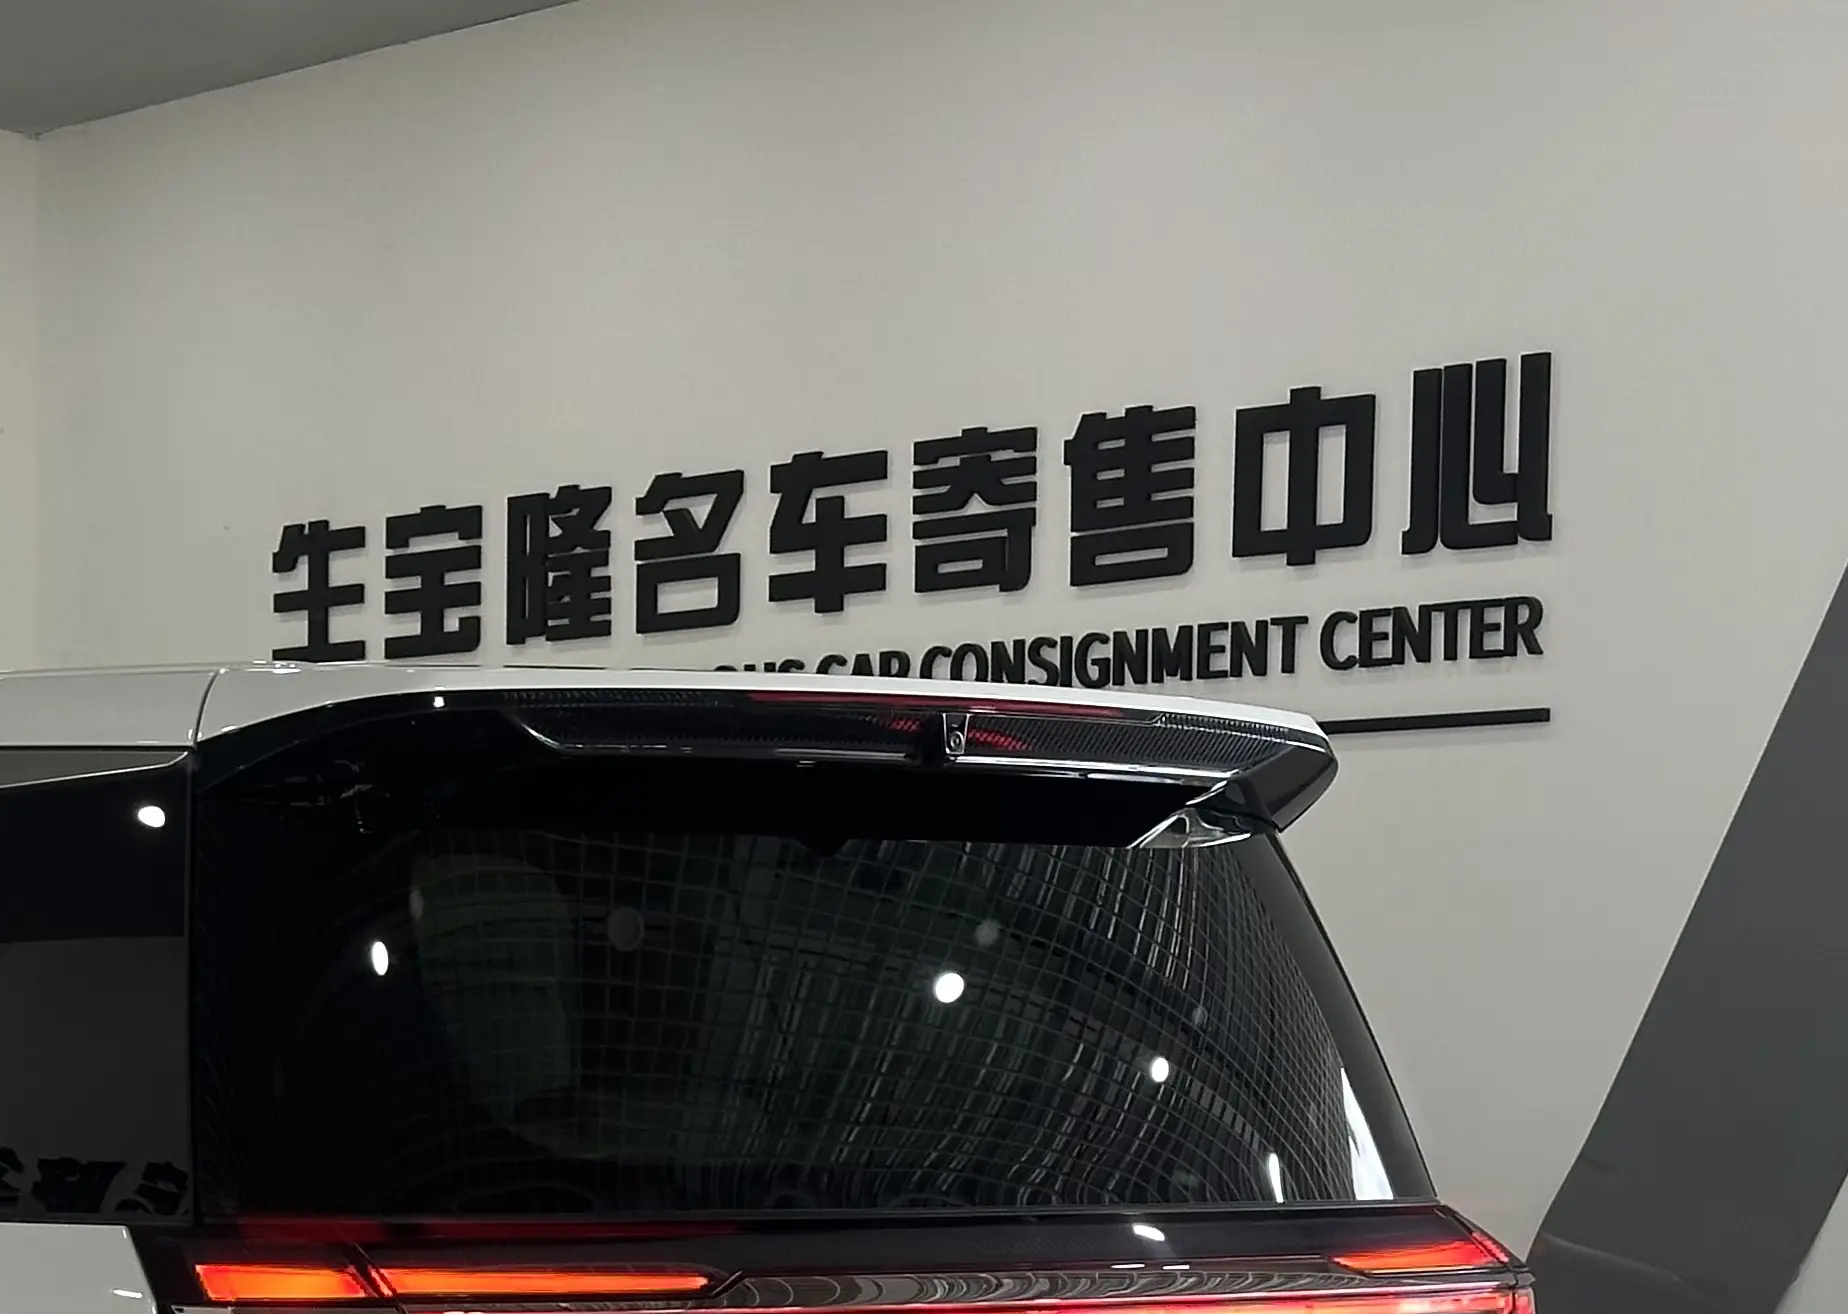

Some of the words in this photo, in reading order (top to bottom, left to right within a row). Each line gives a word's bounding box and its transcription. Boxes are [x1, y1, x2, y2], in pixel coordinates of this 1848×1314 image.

[272, 352, 1553, 661] 生宝隆名车寄售中心
[920, 615, 1309, 690] CONSIGNMENT
[1319, 596, 1544, 671] CENTER
